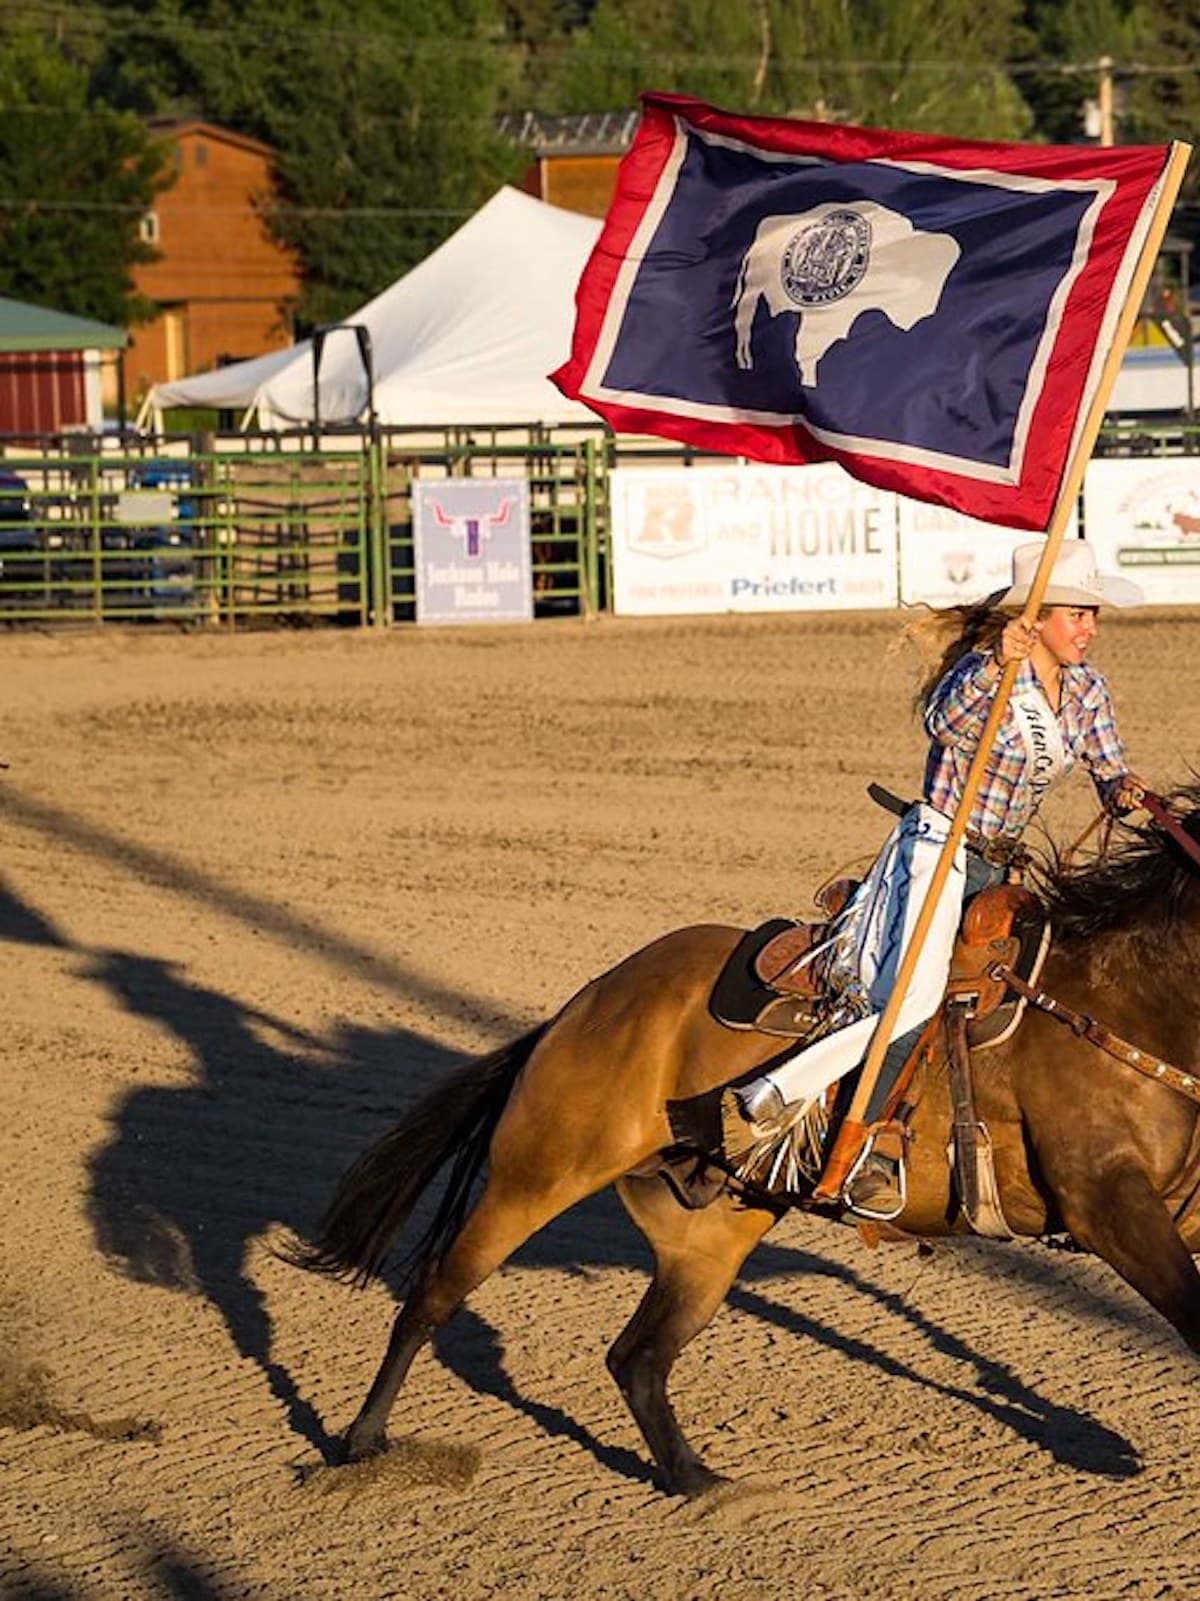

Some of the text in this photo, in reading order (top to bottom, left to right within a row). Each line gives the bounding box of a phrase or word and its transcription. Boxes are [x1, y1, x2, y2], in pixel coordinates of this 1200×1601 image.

[710, 475, 880, 505] RANCH
[769, 507, 881, 556] HOME
[731, 576, 838, 597] Priefert
